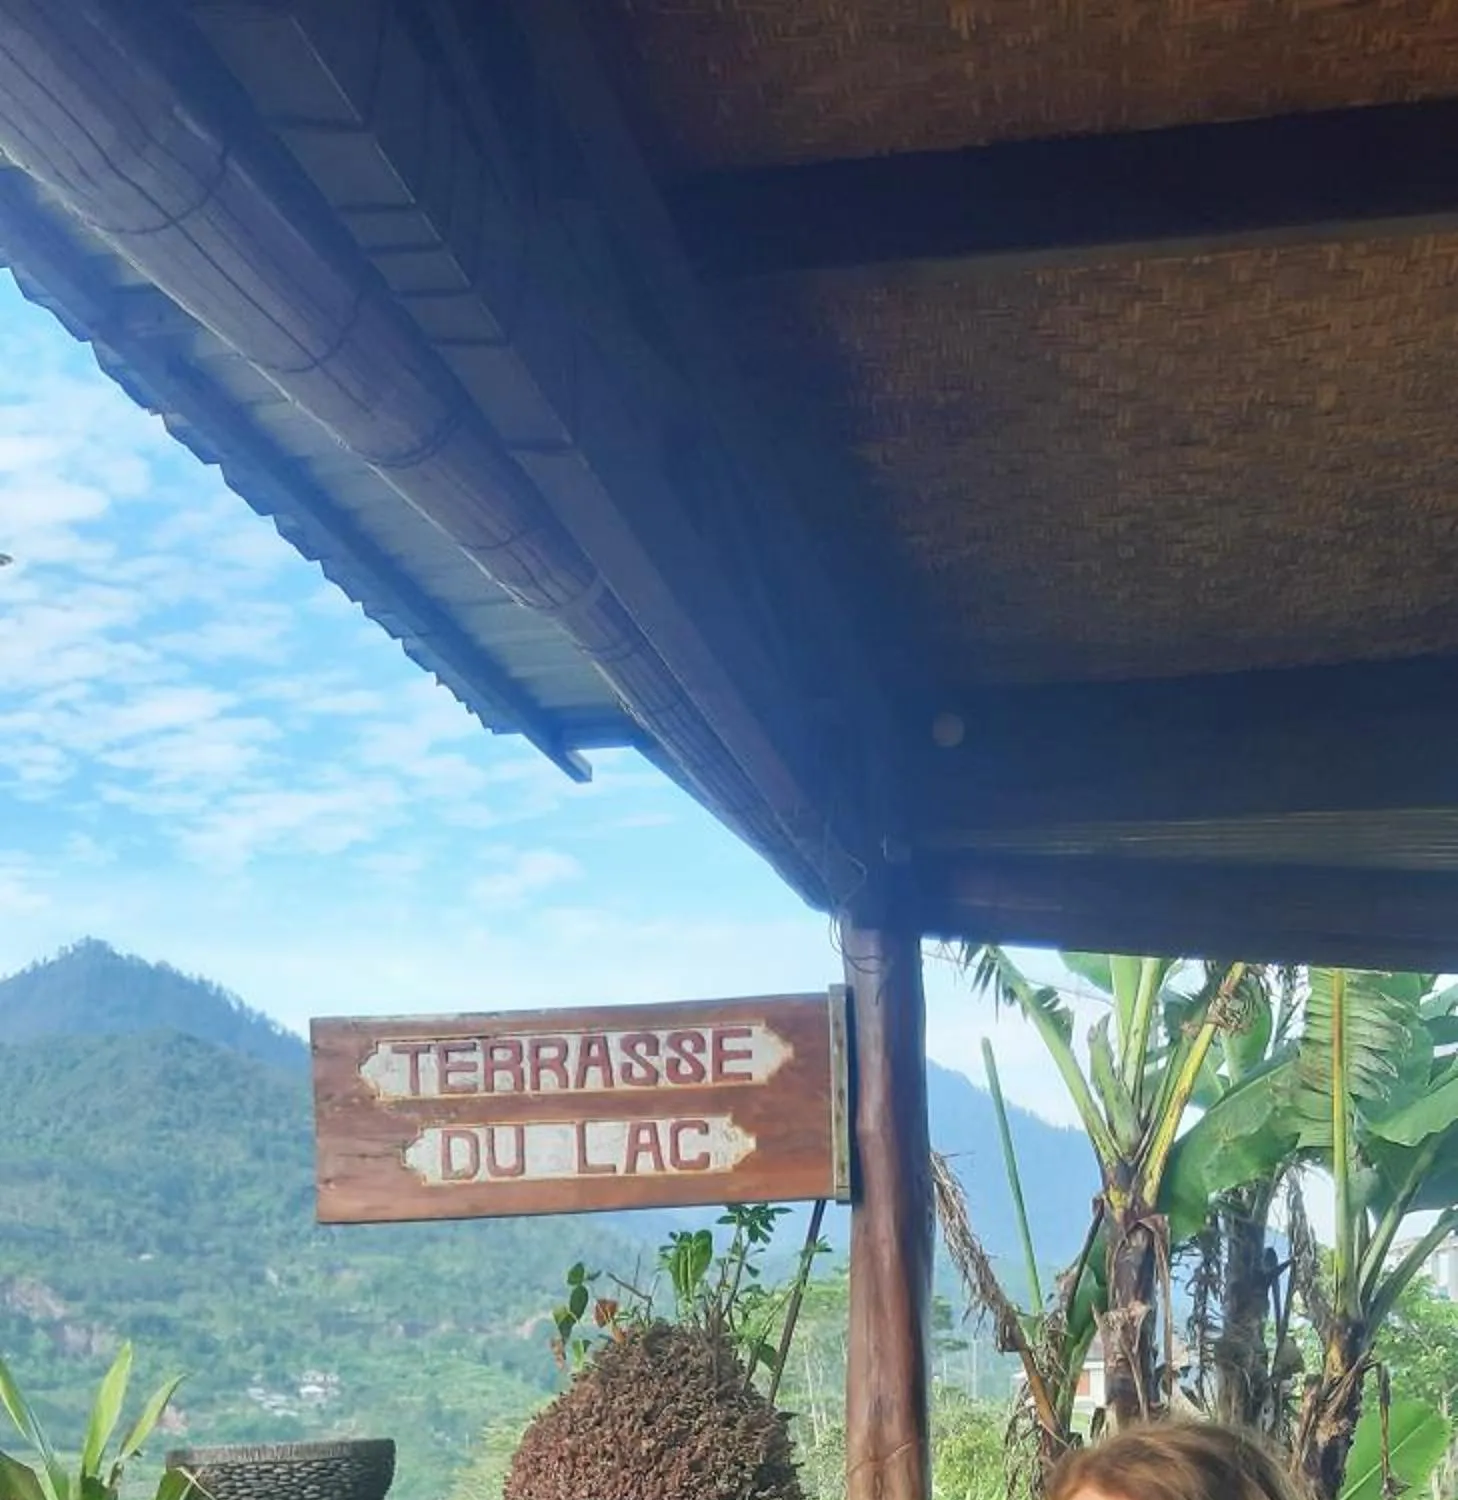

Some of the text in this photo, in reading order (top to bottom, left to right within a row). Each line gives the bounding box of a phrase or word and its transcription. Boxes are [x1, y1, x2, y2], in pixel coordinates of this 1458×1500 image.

[391, 1027, 753, 1096] TERRASSE
[439, 1119, 711, 1181] DU LAC
